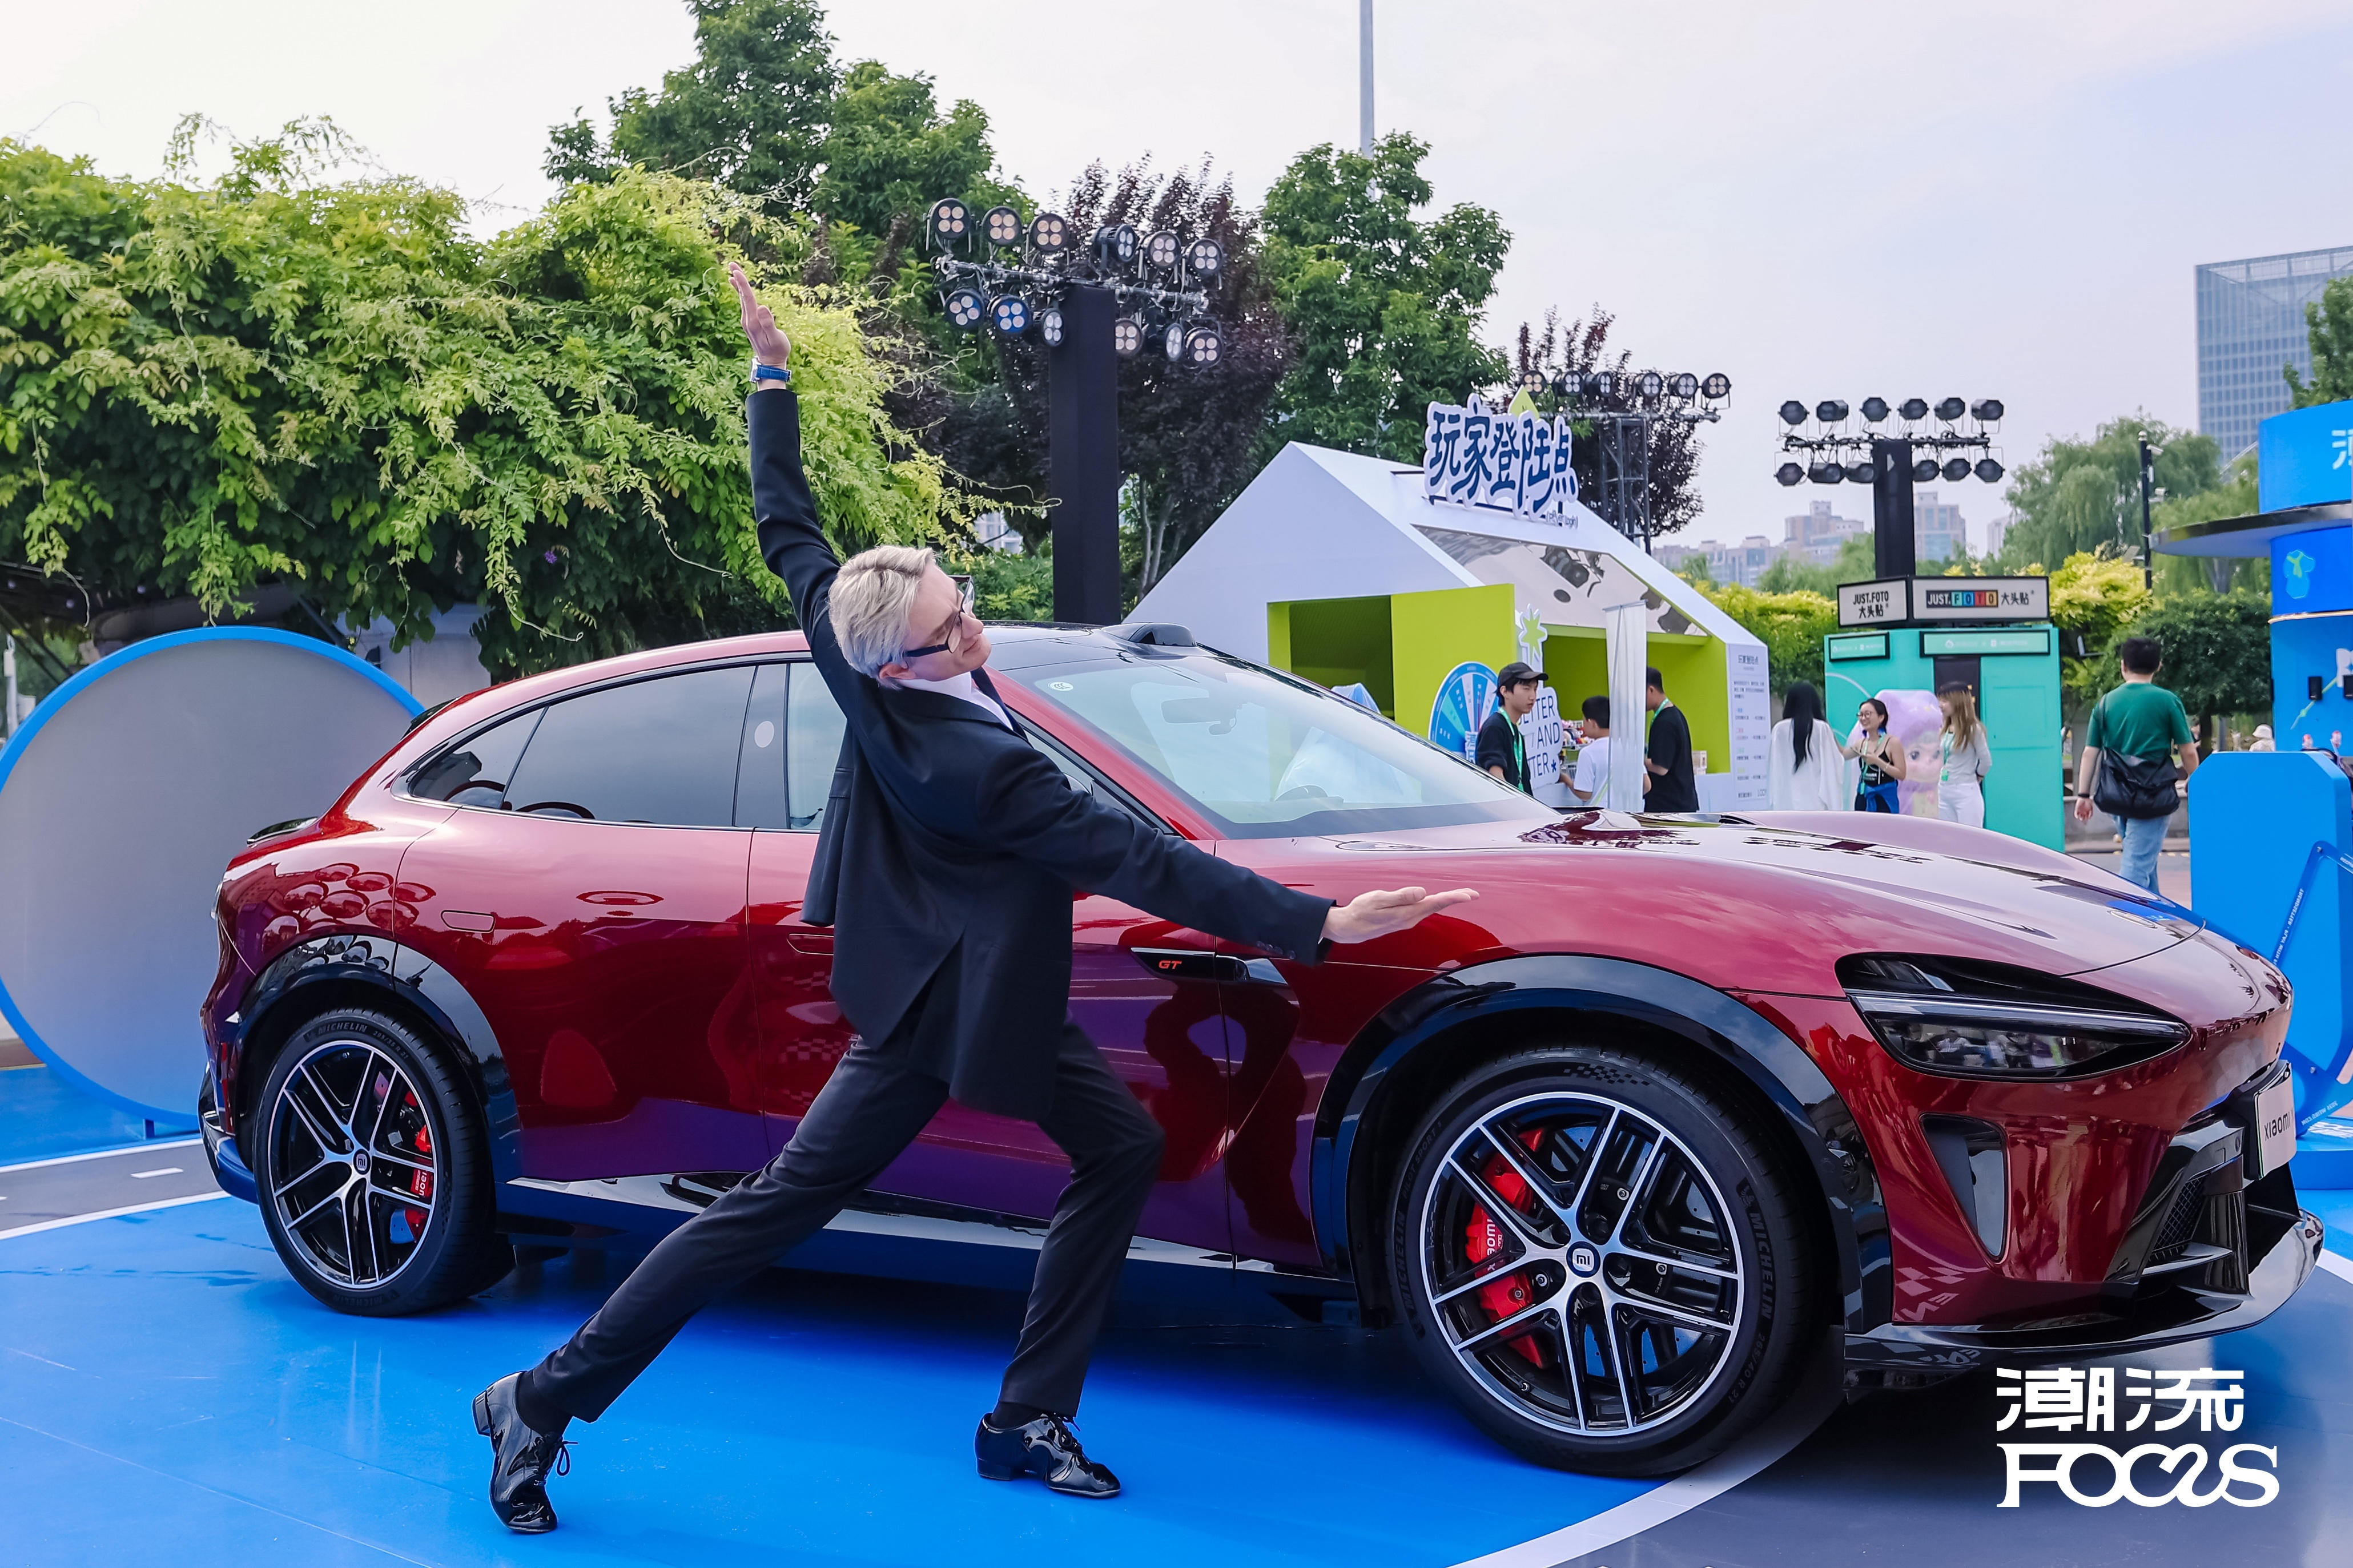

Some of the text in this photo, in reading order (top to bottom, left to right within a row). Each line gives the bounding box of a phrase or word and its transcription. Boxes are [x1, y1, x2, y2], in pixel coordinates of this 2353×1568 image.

[1429, 402, 1576, 514] 玩家登陆点
[1853, 591, 1889, 605] JUST.FOTO
[1859, 605, 1884, 619] 大头贴
[1926, 591, 1994, 606] JUST.FOTO
[2001, 592, 2029, 606] 大头贴
[1537, 721, 1560, 749] AND
[1158, 960, 1182, 970] GT
[317, 1022, 368, 1035] MICHELIN
[2264, 1112, 2291, 1141] xiaomi
[1413, 1131, 1436, 1164] SPORT
[1402, 1164, 1417, 1199] PILOT
[1396, 1211, 1414, 1311] MICHELIN
[1749, 1212, 1773, 1319] MICHELIN
